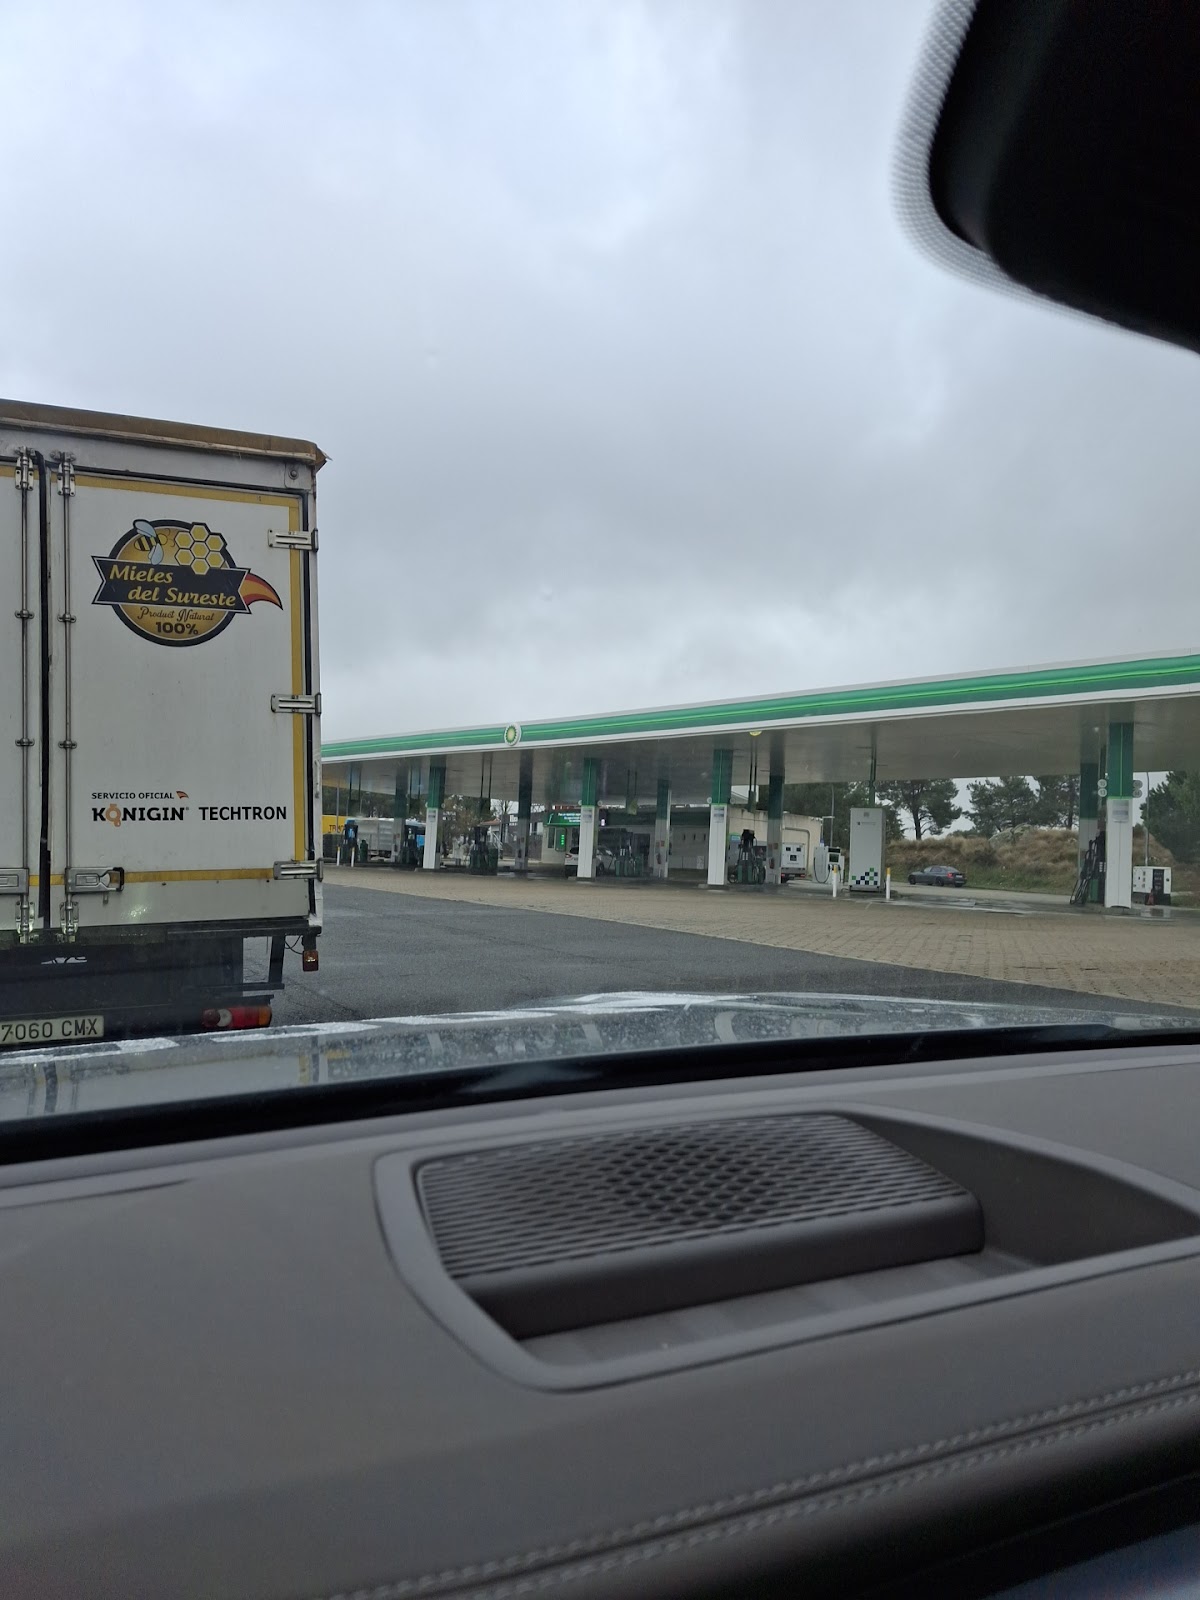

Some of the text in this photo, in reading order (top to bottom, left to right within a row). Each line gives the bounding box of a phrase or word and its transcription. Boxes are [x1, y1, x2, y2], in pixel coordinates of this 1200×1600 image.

[109, 564, 174, 584] Mieles
[127, 585, 237, 607] del Sureste
[137, 606, 215, 623] Product Natural
[155, 621, 199, 635] 100%
[91, 792, 175, 800] SERVICIO OFICIAL
[198, 806, 287, 821] TECHTRON
[1, 1017, 98, 1042] 7060 CMX
